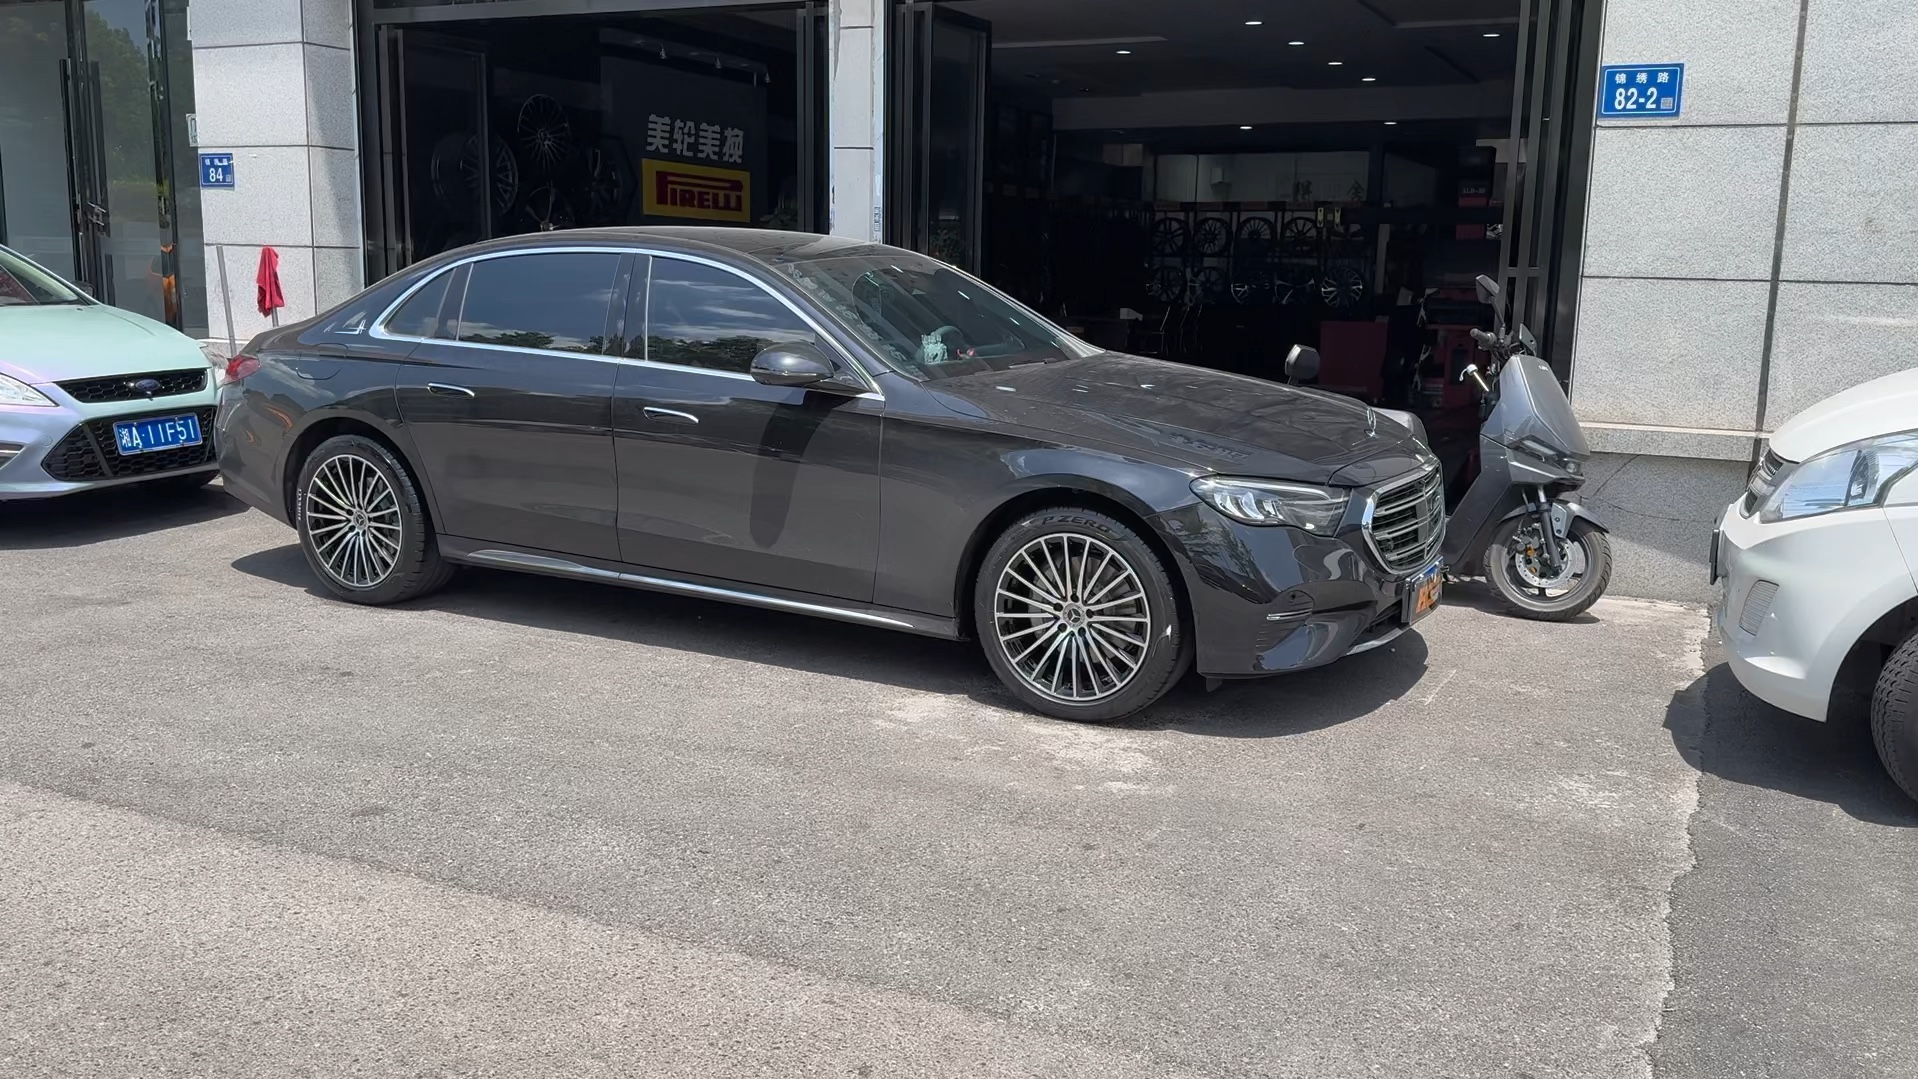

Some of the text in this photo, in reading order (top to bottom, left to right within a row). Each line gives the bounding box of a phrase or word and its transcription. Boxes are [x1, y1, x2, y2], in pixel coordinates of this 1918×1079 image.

[1615, 72, 1669, 84] 锦绣路
[1614, 87, 1658, 109] 82-2
[646, 114, 744, 163] 美轮美换
[209, 167, 223, 182] 84
[655, 171, 743, 212] PIRELLI
[1041, 515, 1111, 532] P ZERO
